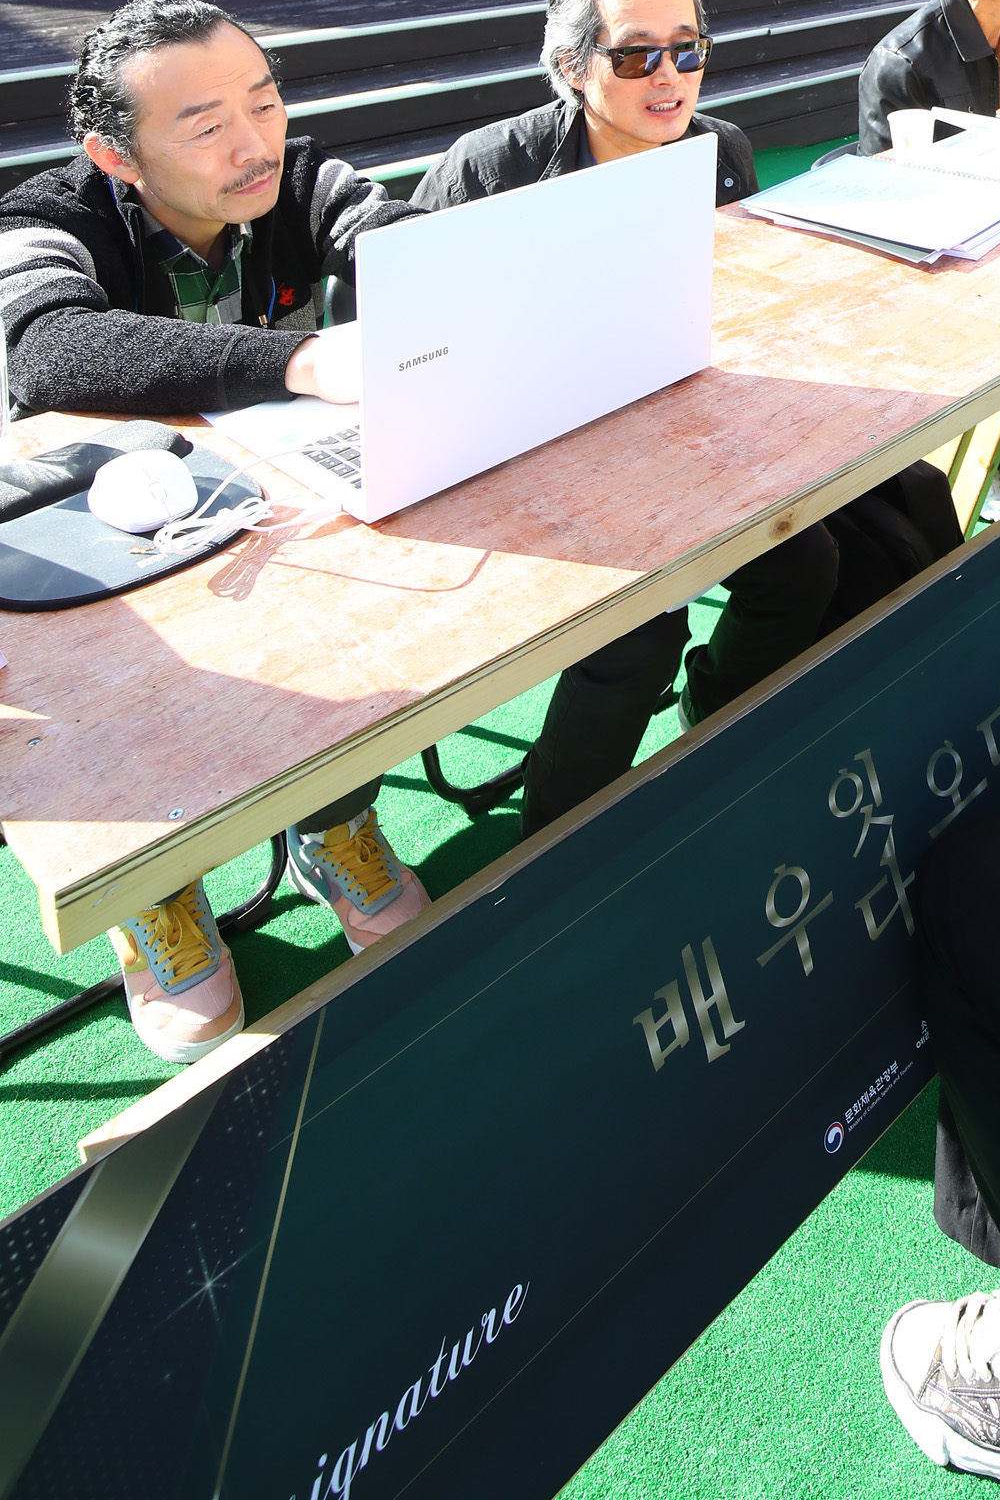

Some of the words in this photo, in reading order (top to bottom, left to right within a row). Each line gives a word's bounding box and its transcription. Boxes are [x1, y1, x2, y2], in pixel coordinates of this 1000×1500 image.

[398, 346, 449, 372] SAMSUNG
[632, 862, 835, 1071] 배우
[844, 1060, 899, 1124] 문화체육관광부
[290, 1281, 530, 1500] ignature
